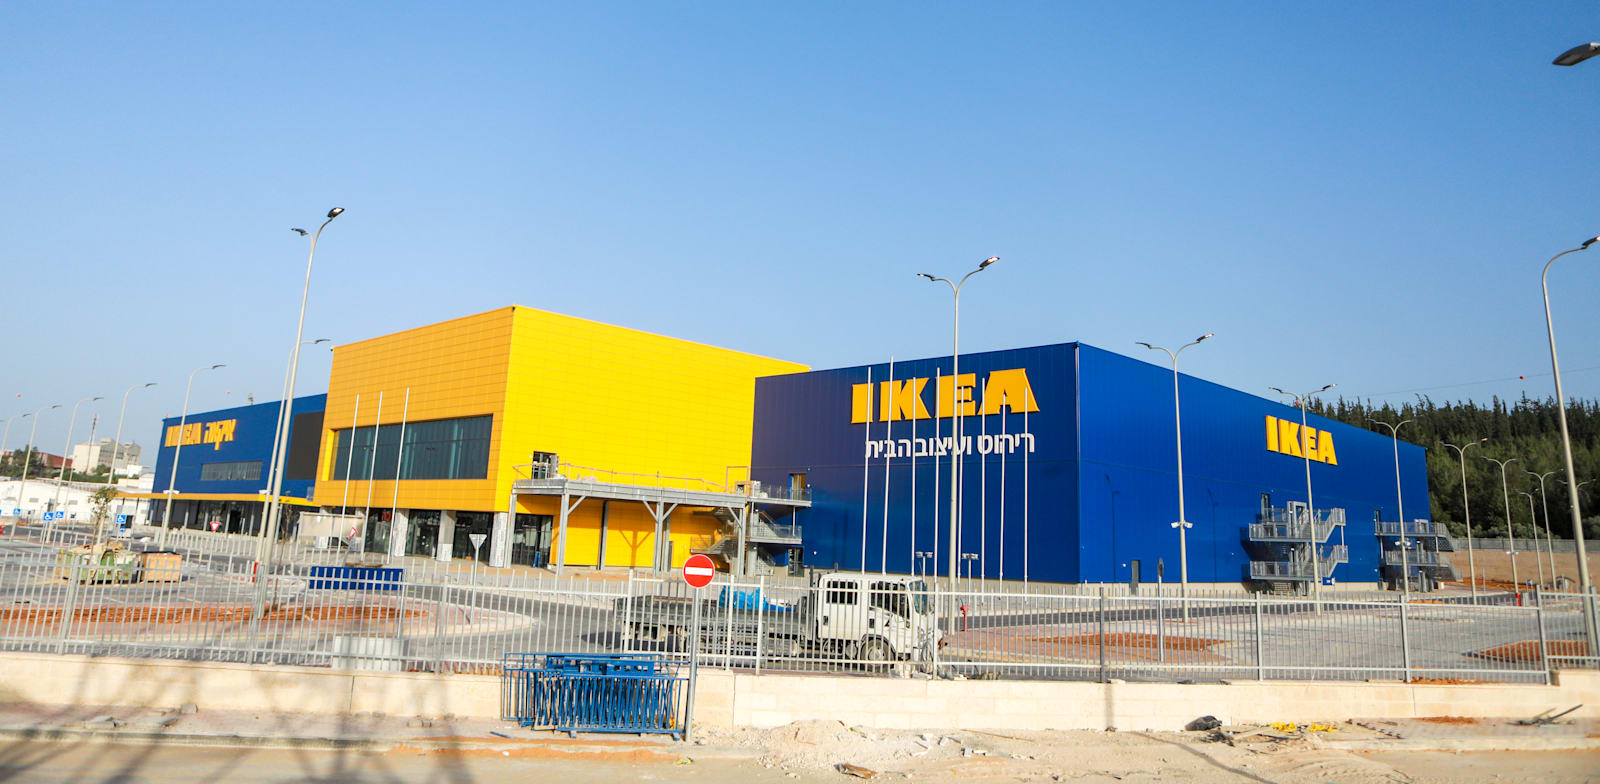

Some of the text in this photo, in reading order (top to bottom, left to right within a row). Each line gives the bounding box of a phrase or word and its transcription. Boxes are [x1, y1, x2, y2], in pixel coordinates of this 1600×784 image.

[851, 368, 1040, 423] IKEA
[865, 433, 1035, 459] ריהוט ועיצוב הבית
[1265, 415, 1338, 465] IKEA
